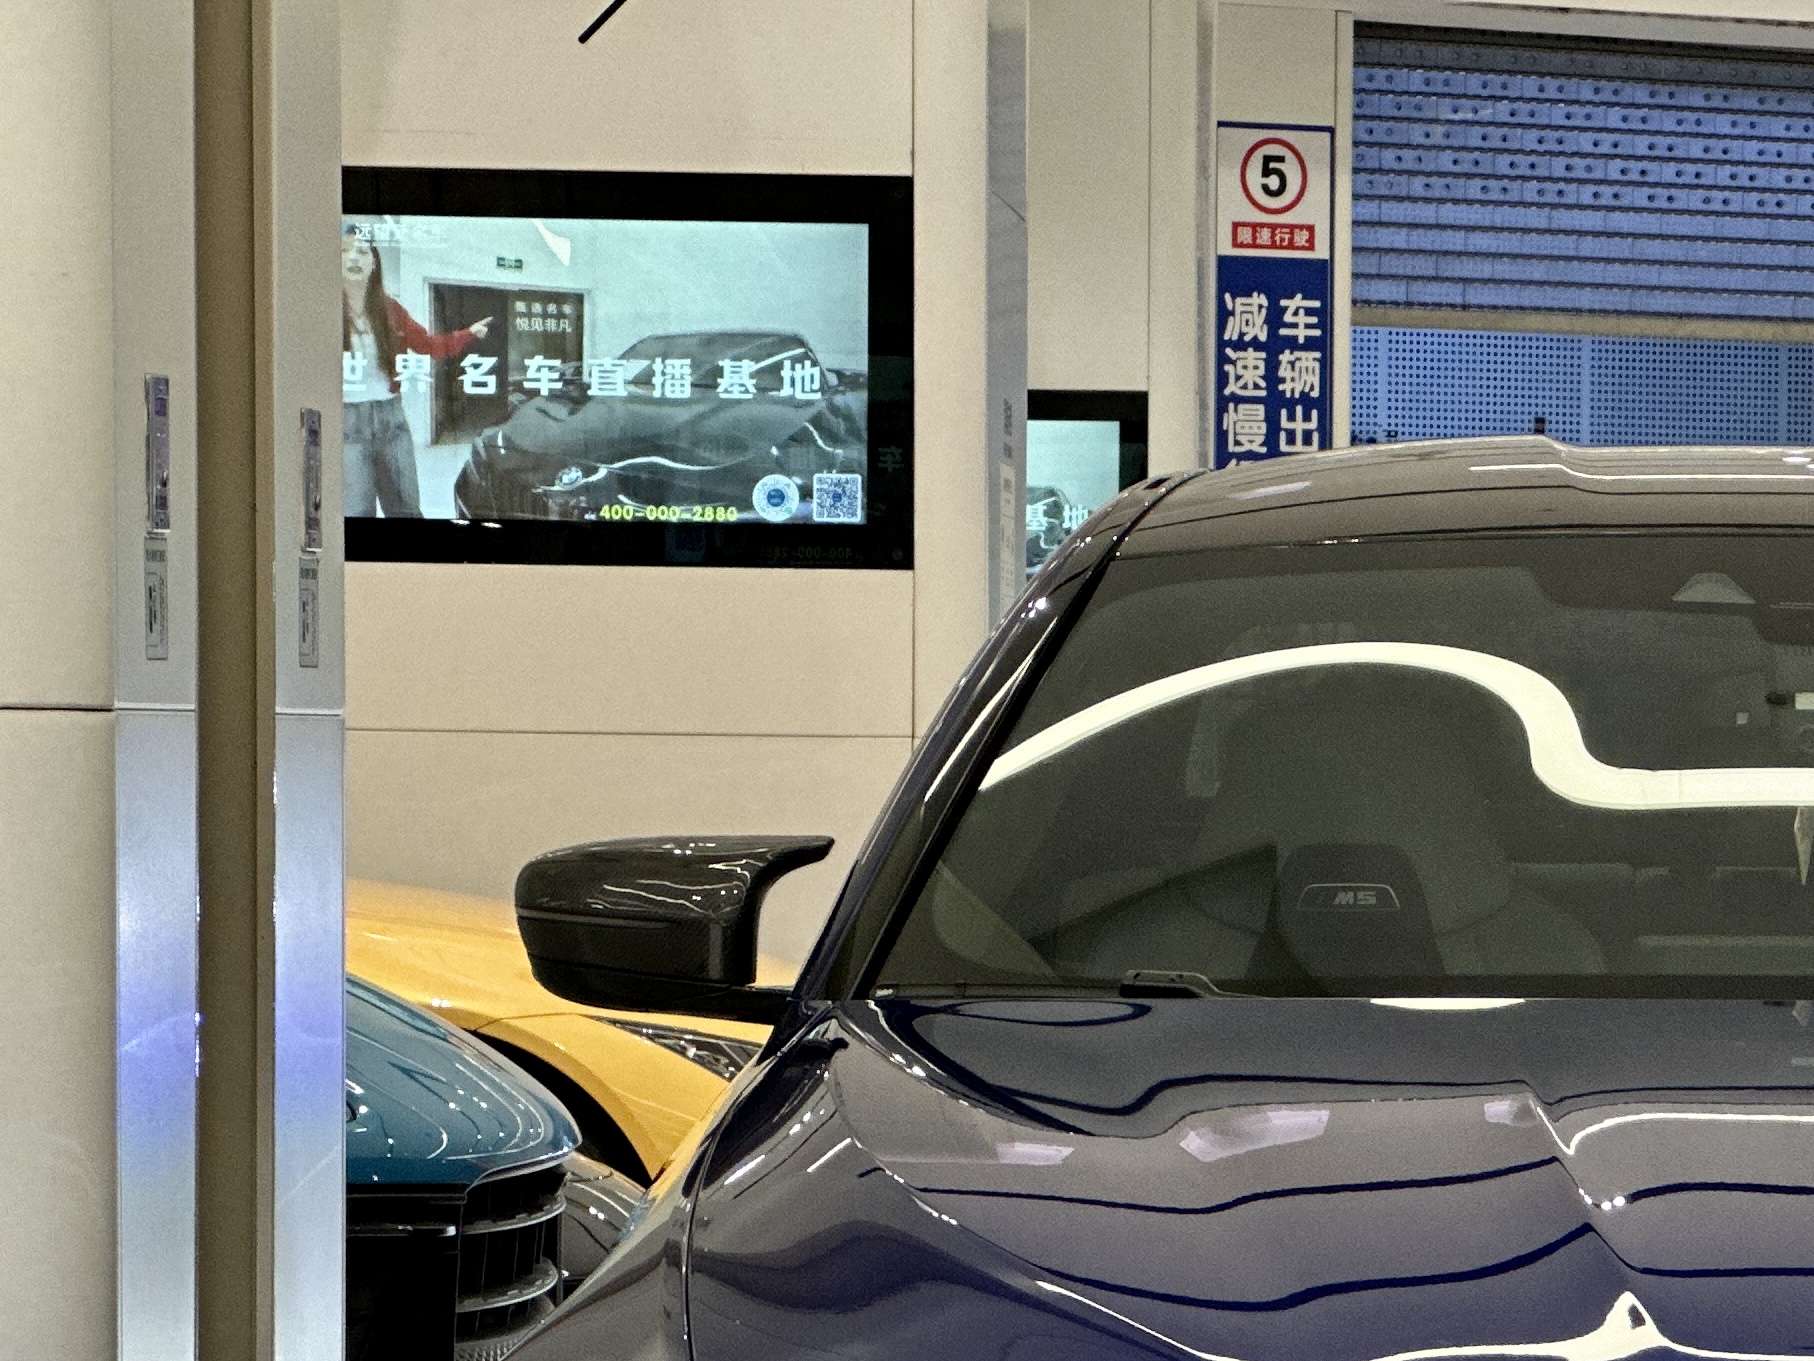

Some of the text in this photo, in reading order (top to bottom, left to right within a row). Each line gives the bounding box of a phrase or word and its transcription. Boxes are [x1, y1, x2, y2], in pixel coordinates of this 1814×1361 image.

[1260, 154, 1288, 198] 5
[1236, 225, 1312, 247] 限速行驶
[1223, 291, 1269, 468] 减速慢
[1333, 891, 1377, 905] M5
